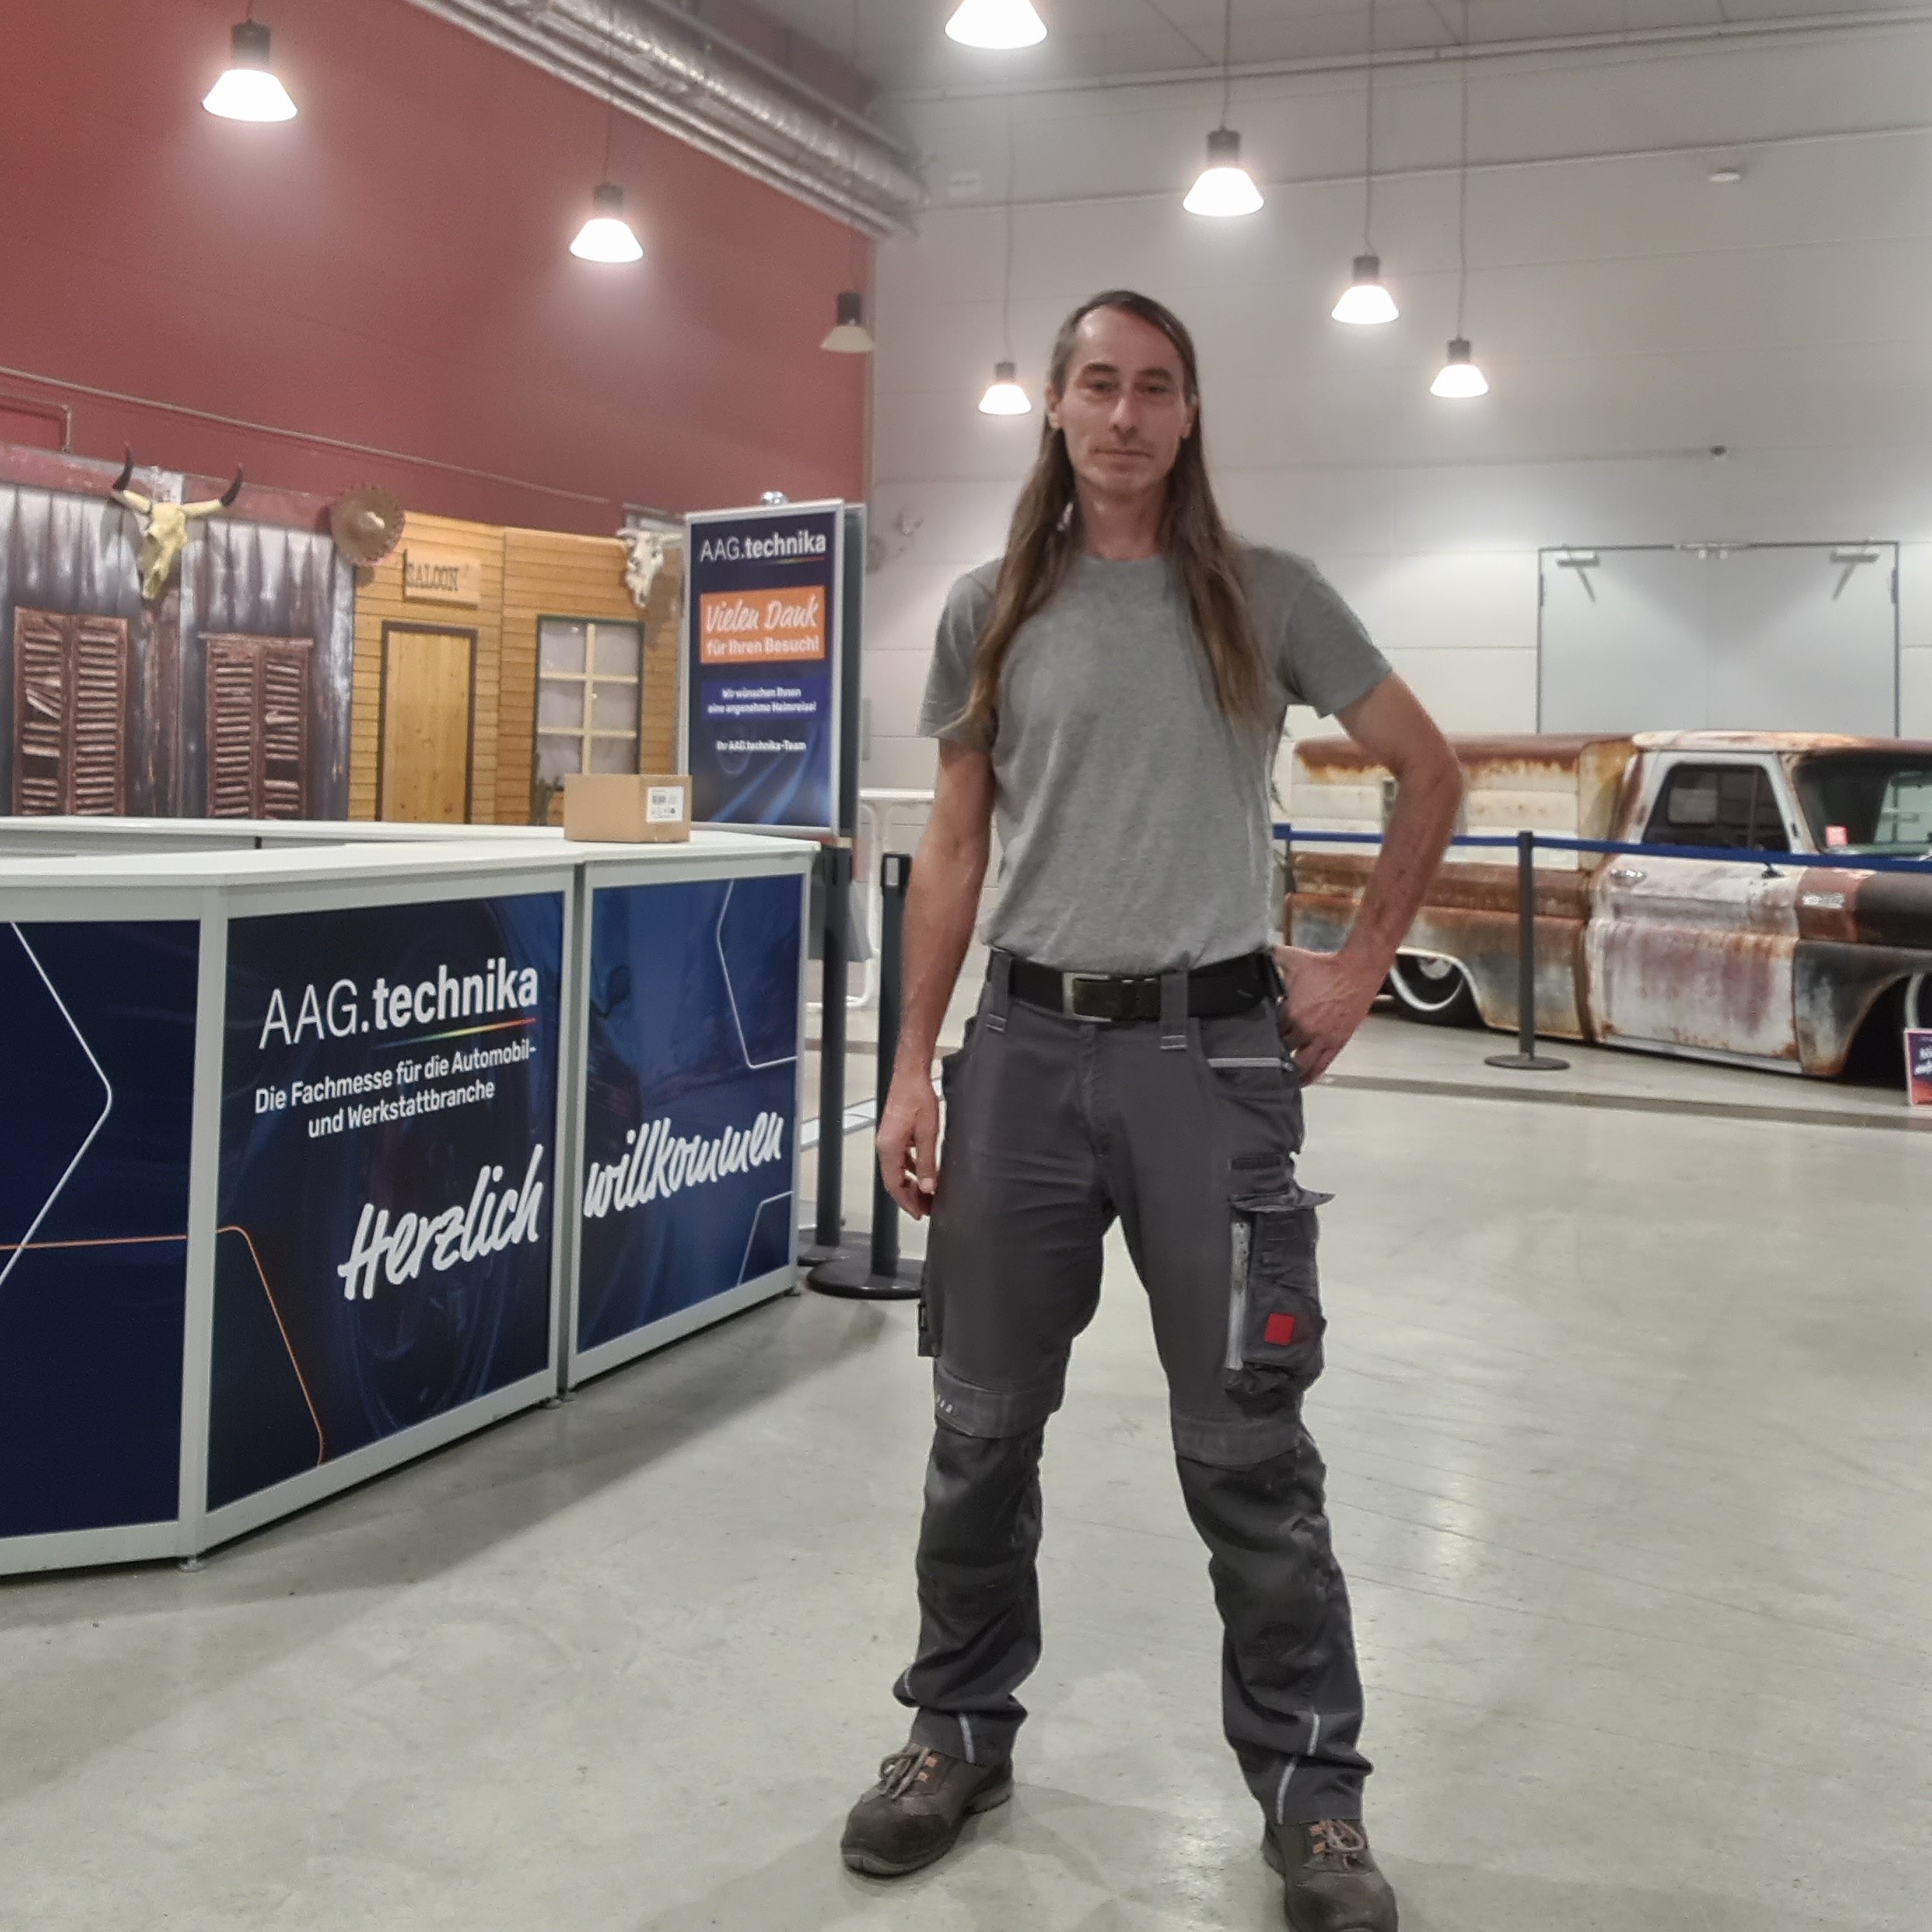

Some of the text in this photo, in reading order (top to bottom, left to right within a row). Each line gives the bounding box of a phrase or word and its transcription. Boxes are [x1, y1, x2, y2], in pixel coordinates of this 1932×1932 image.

[700, 529, 827, 562] AAG.technika
[706, 594, 819, 633] Vielen Dank
[707, 634, 819, 655] für Ihren Besuch!
[259, 957, 539, 1050] AAG.technika
[255, 1038, 536, 1114] Die Fachmesse für die Automobil-
[308, 1078, 496, 1138] und Werkstattbranche
[337, 1111, 784, 1300] Herzlich willkommen
